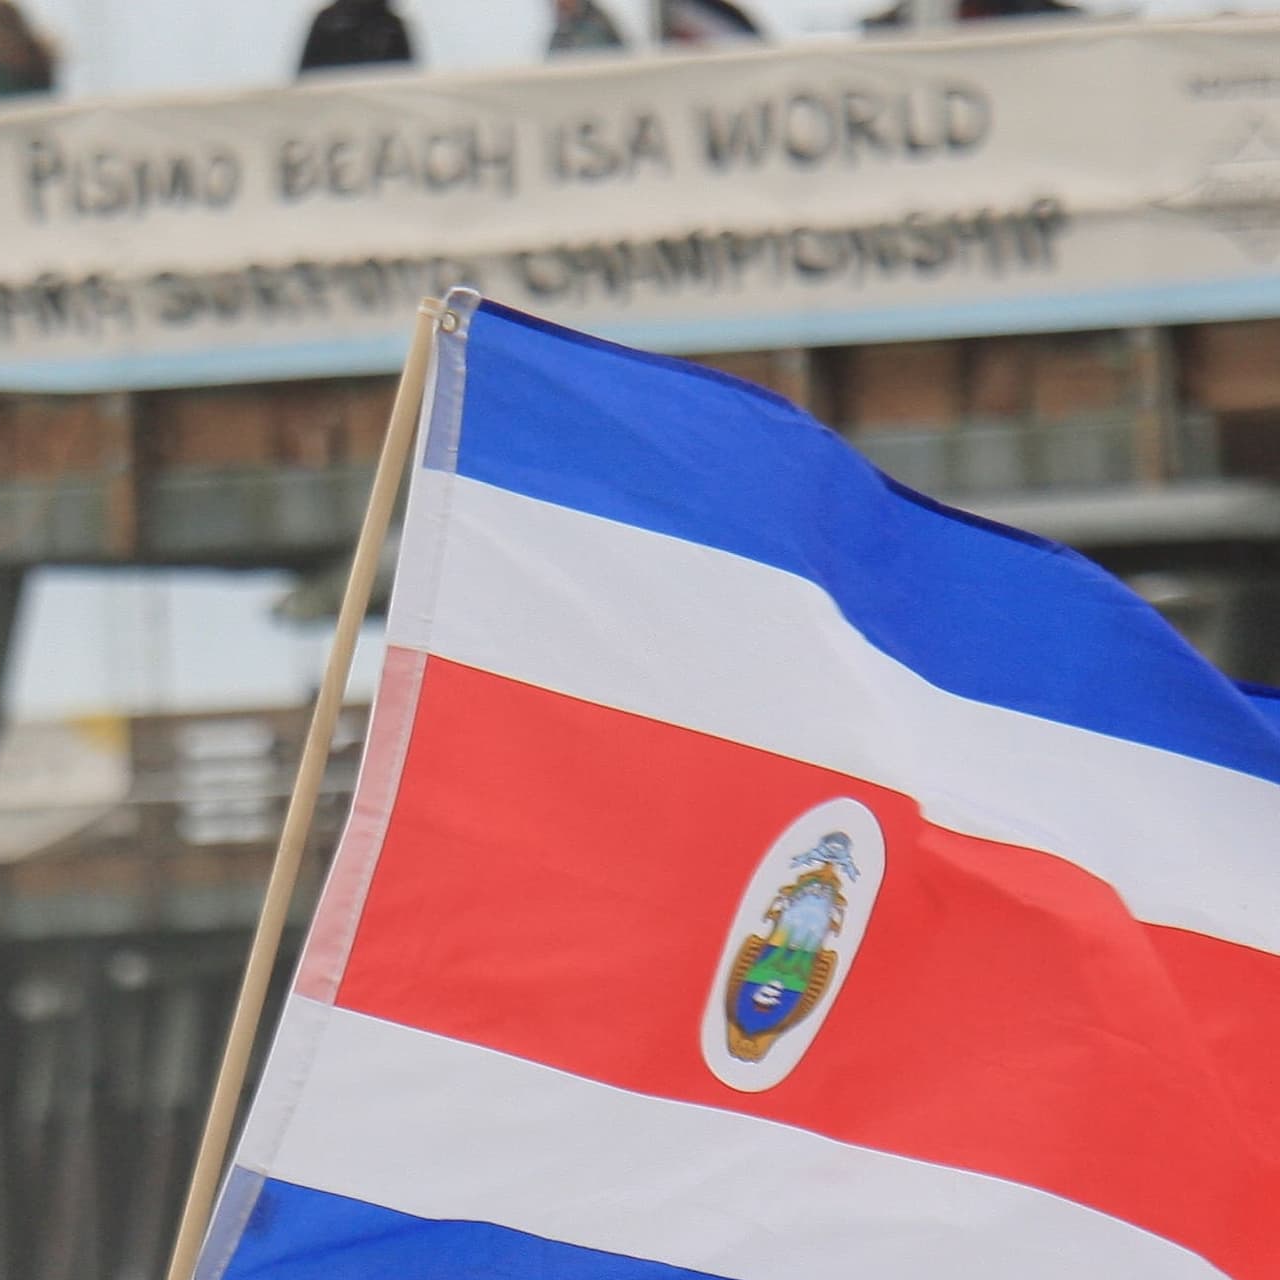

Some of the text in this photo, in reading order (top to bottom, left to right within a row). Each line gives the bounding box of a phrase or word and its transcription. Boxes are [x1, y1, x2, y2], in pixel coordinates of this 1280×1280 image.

[21, 131, 242, 222] PISMO
[279, 120, 518, 200] BEACH
[554, 109, 672, 182] ISA
[698, 78, 994, 172] WORLD
